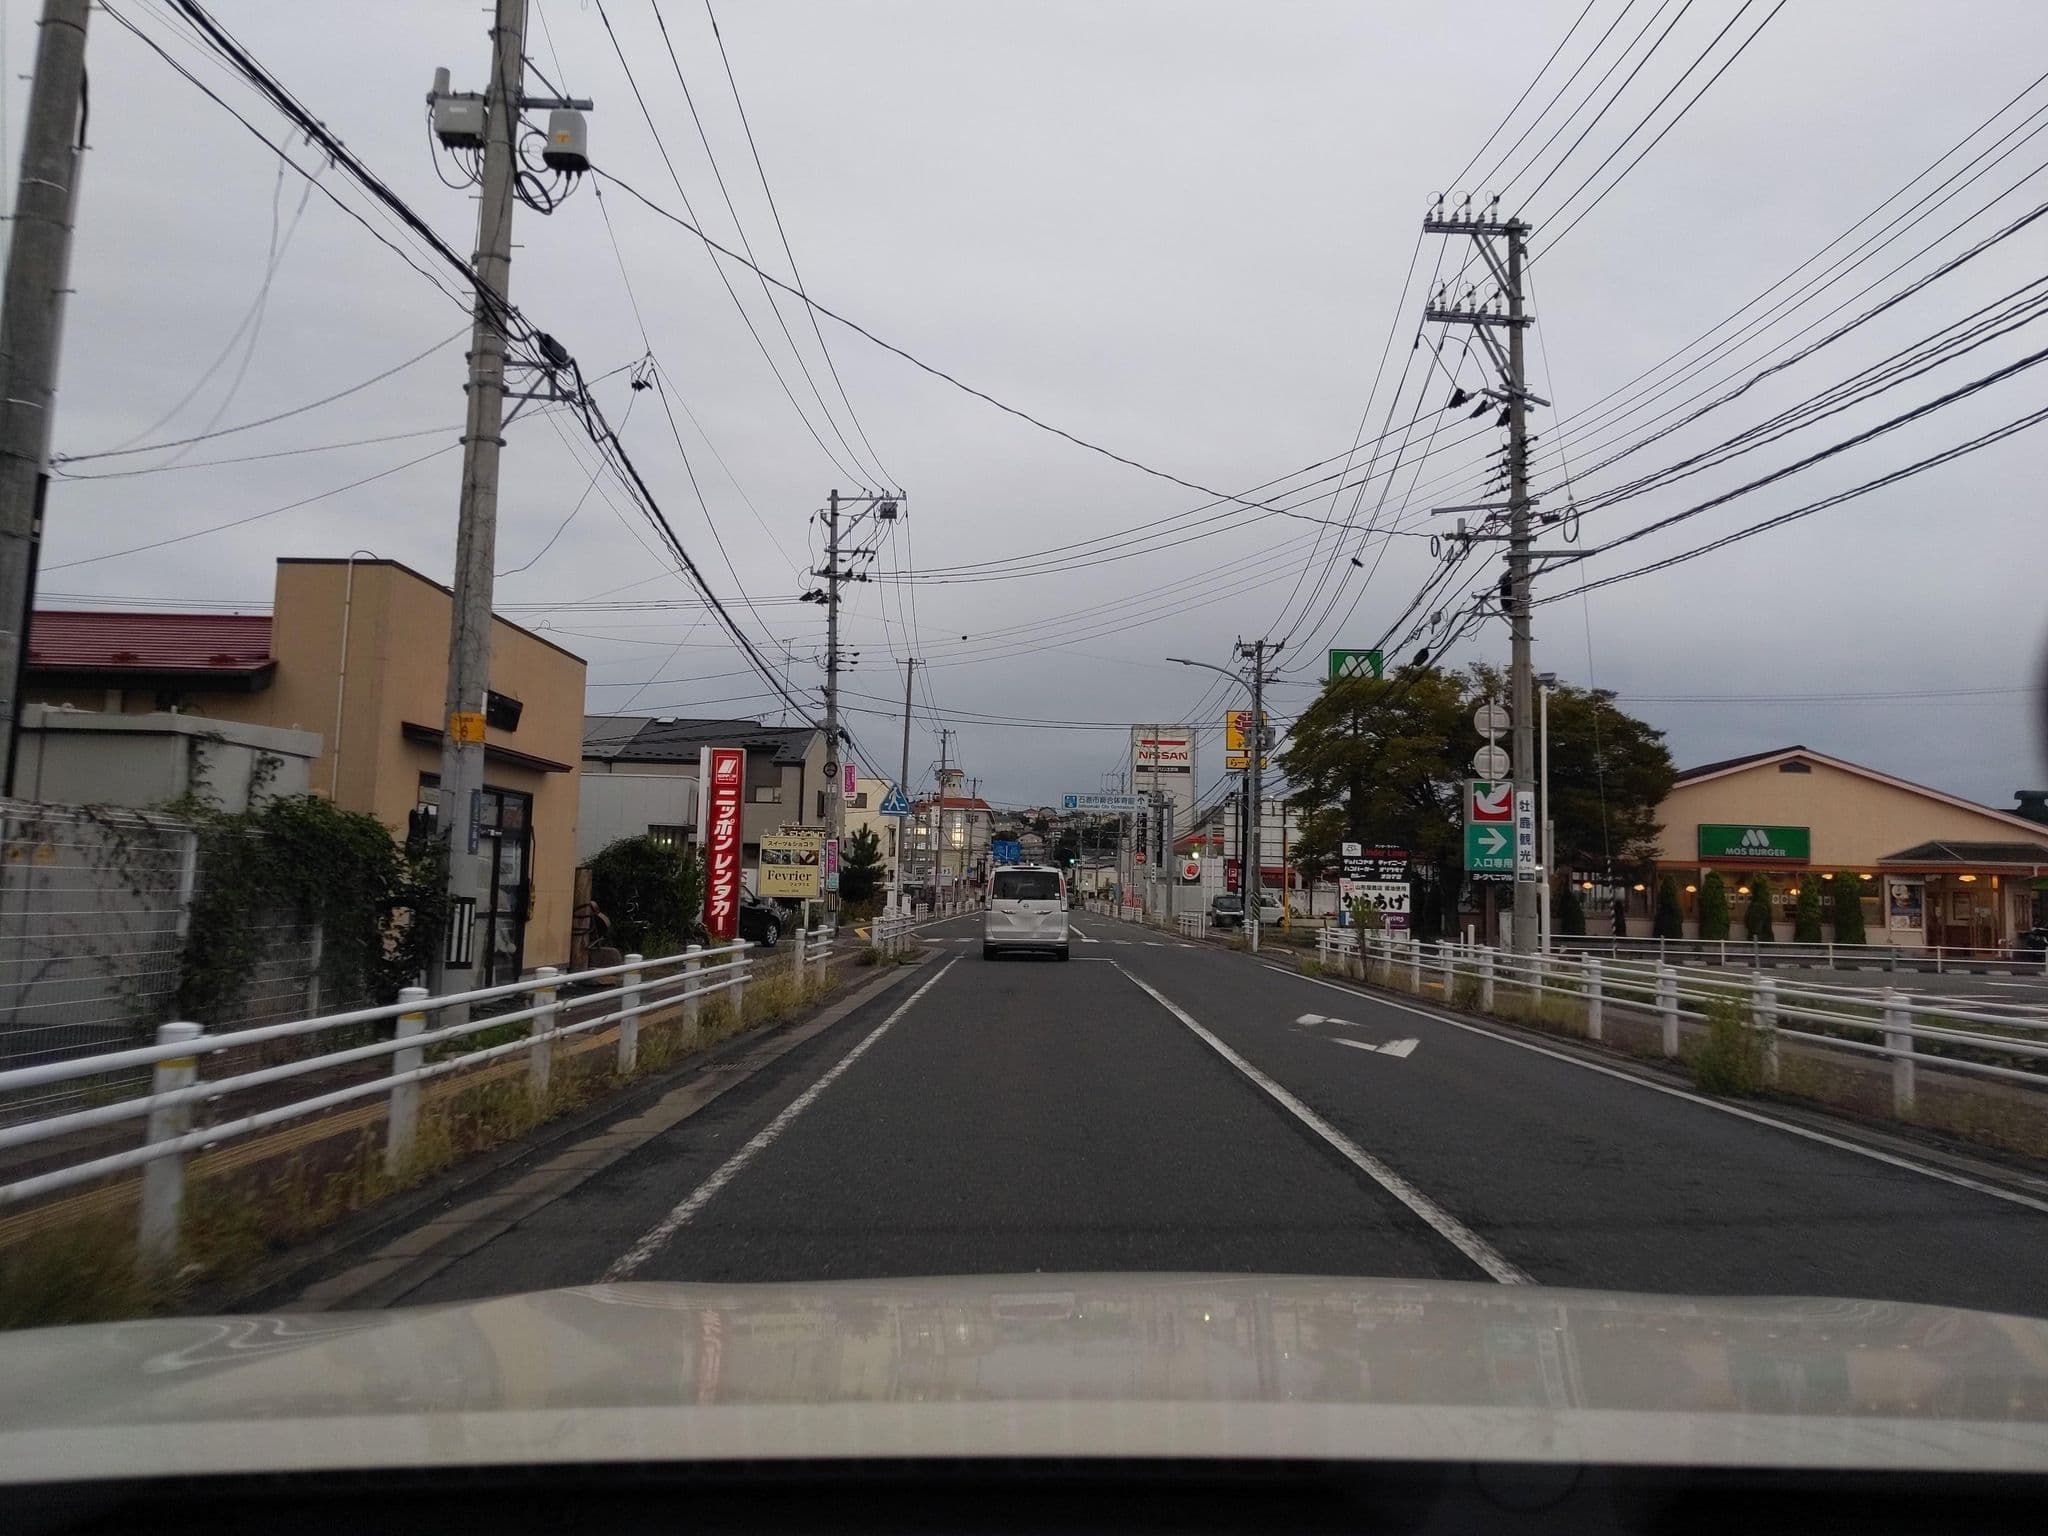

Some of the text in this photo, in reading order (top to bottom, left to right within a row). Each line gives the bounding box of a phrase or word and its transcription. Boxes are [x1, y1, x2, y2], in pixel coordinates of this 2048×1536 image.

[1138, 751, 1188, 761] NISSAN
[1519, 800, 1531, 862] 牡鹿観光
[1725, 847, 1786, 857] MOS BURGER
[711, 789, 736, 931] ニッポンレンタカー
[1473, 858, 1513, 869] 入口専用
[767, 870, 812, 881] Fevrier
[1472, 873, 1513, 881] ヨークベニマル
